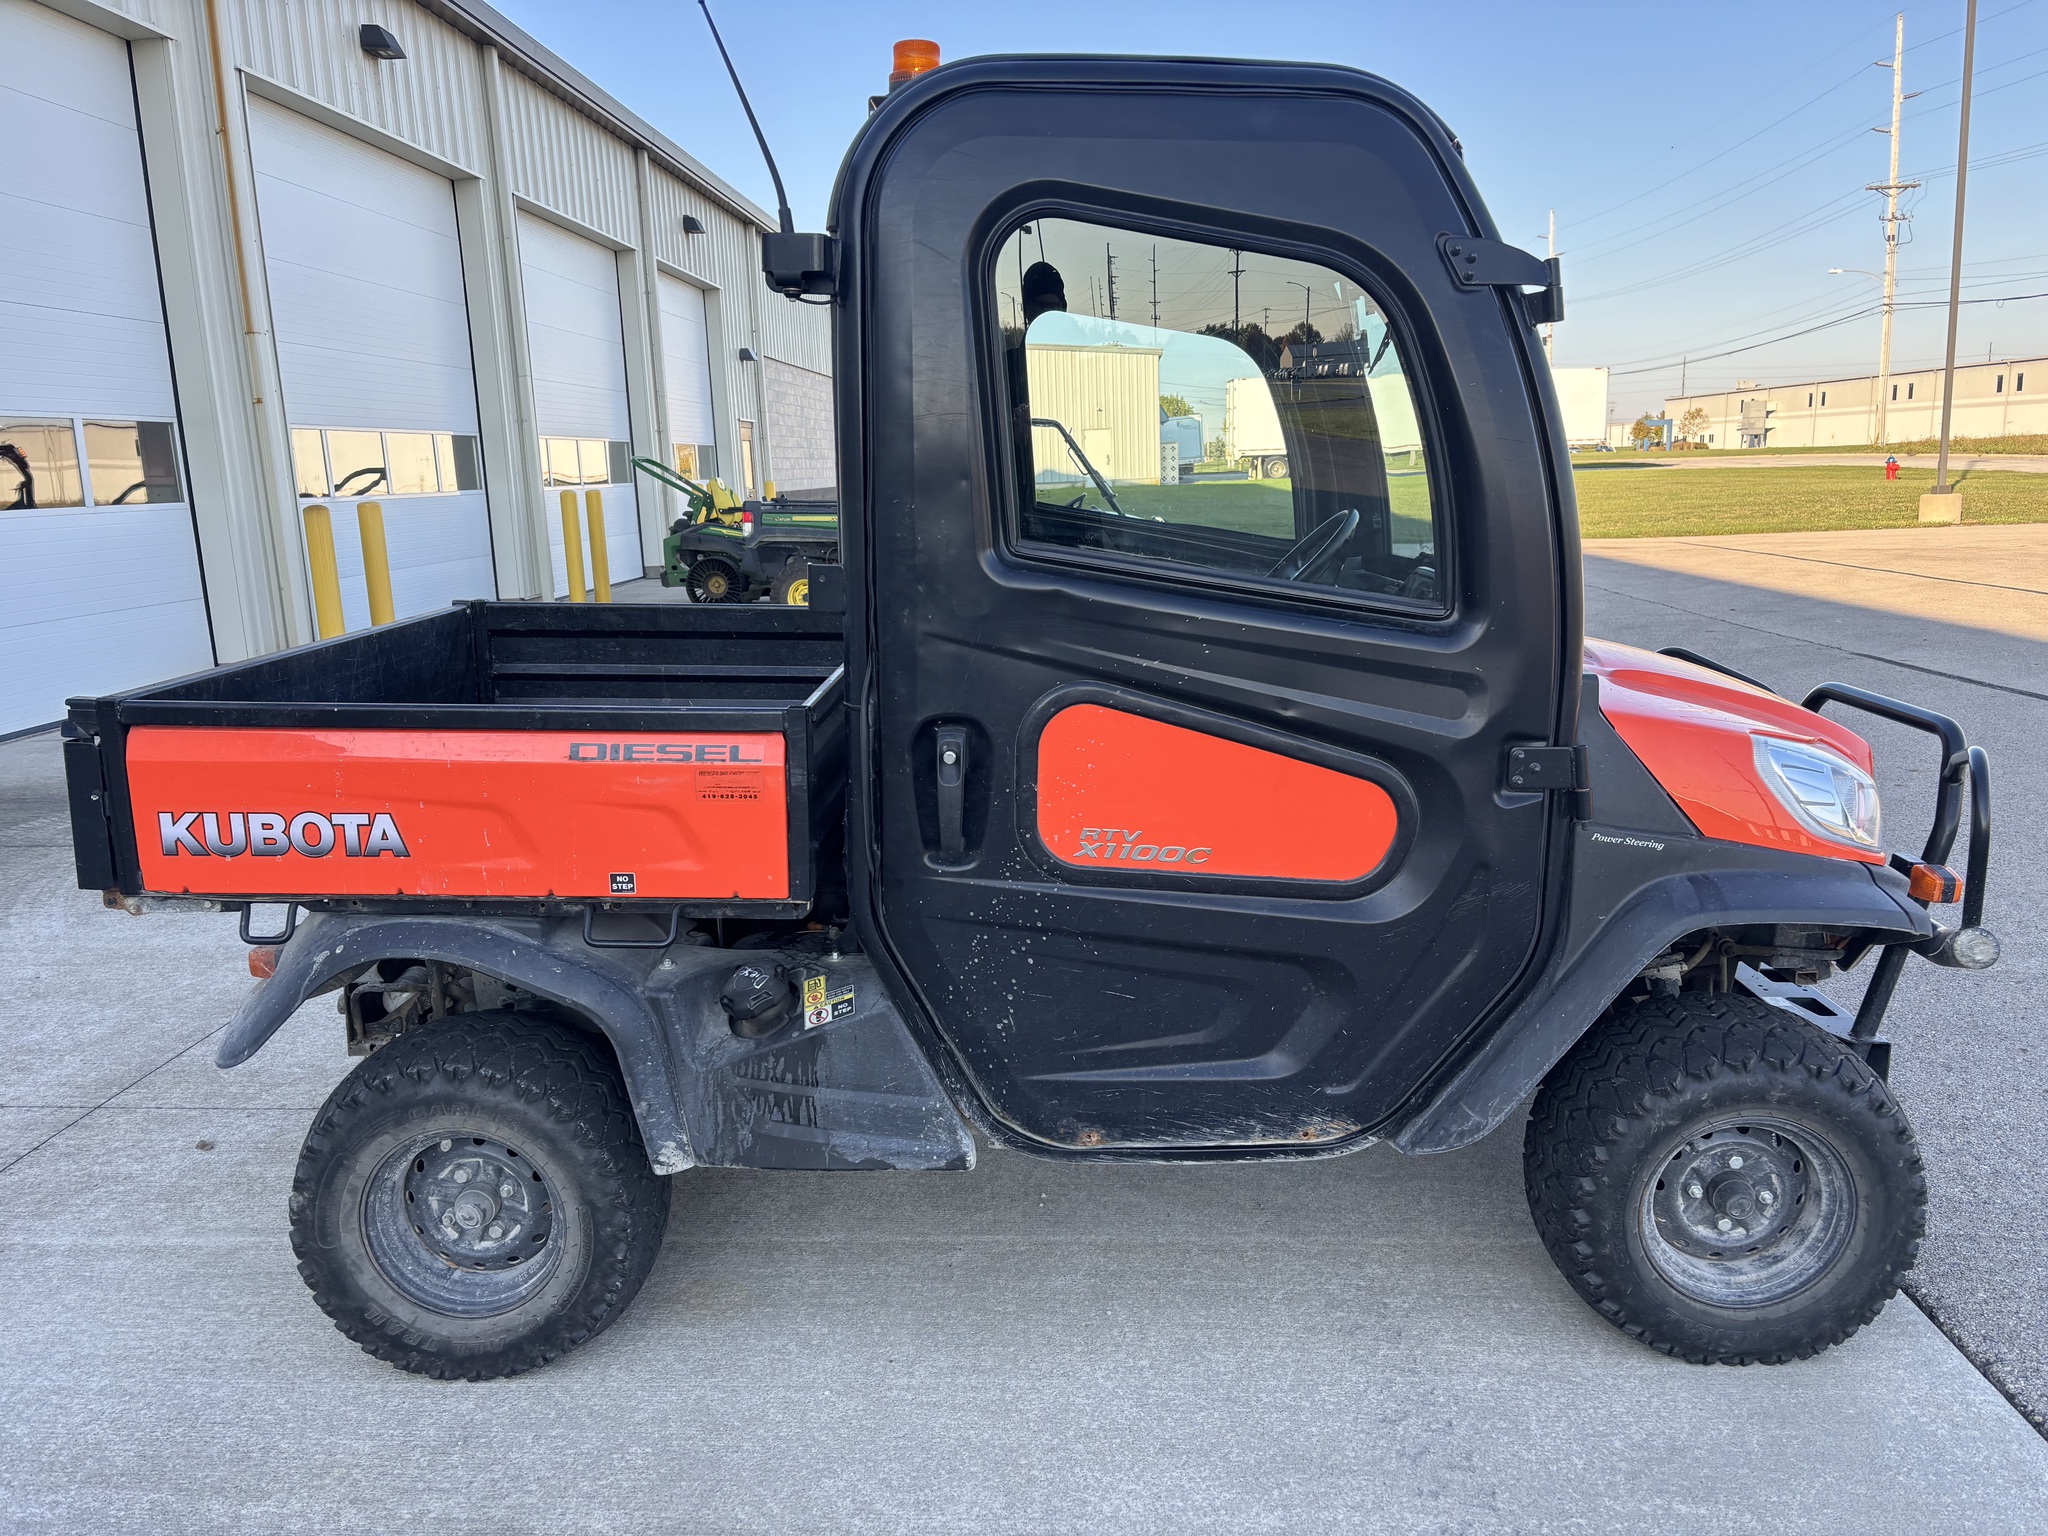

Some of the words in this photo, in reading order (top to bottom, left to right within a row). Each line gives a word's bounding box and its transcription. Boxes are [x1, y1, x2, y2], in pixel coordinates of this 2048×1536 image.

[569, 742, 763, 764] DIESEL
[157, 811, 411, 858] KUBOTA
[1079, 827, 1143, 842] RTV
[1591, 833, 1624, 844] Power
[1624, 837, 1665, 851] Steering
[1073, 842, 1212, 864] X1100C
[820, 996, 845, 1007] CAUTION
[833, 1006, 852, 1016] STEP
[363, 1302, 441, 1353] TRAIL
[451, 1335, 507, 1355] ALL
